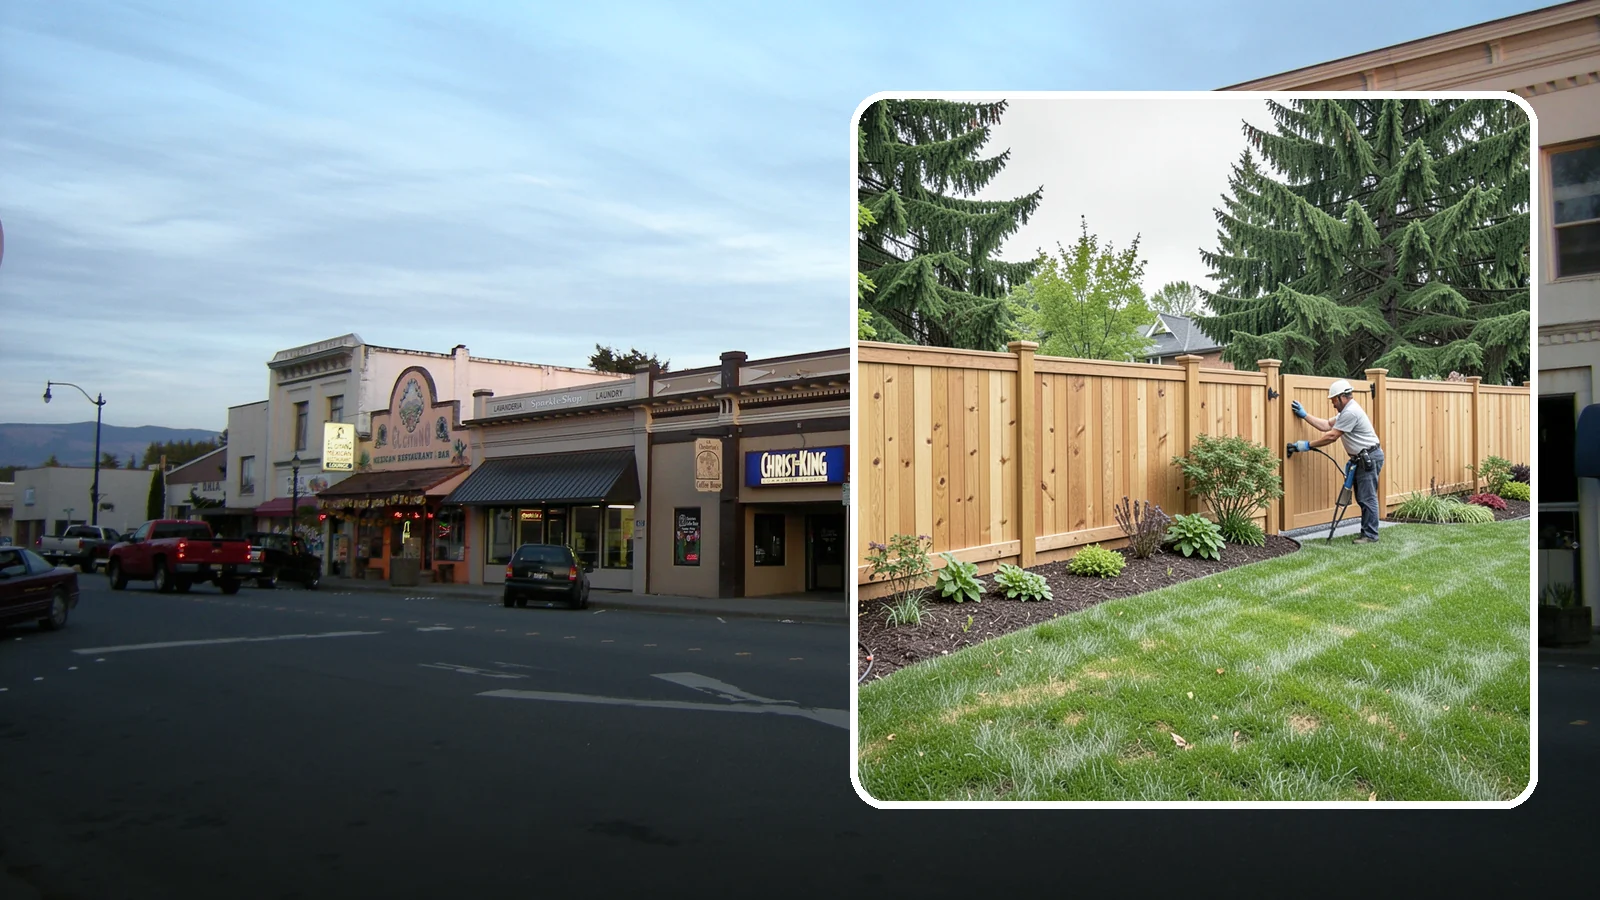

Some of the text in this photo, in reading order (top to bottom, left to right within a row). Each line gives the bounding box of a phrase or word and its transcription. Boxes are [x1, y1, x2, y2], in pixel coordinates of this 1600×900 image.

[595, 389, 624, 400] LAUNDRY
[493, 402, 523, 413] LAVANDERIA
[530, 394, 583, 409] Sparkle Shop
[373, 450, 450, 464] MEXICAN RESTAURANT BAR
[761, 450, 827, 478] CHRIST KING
[696, 481, 722, 489] Coffee House
